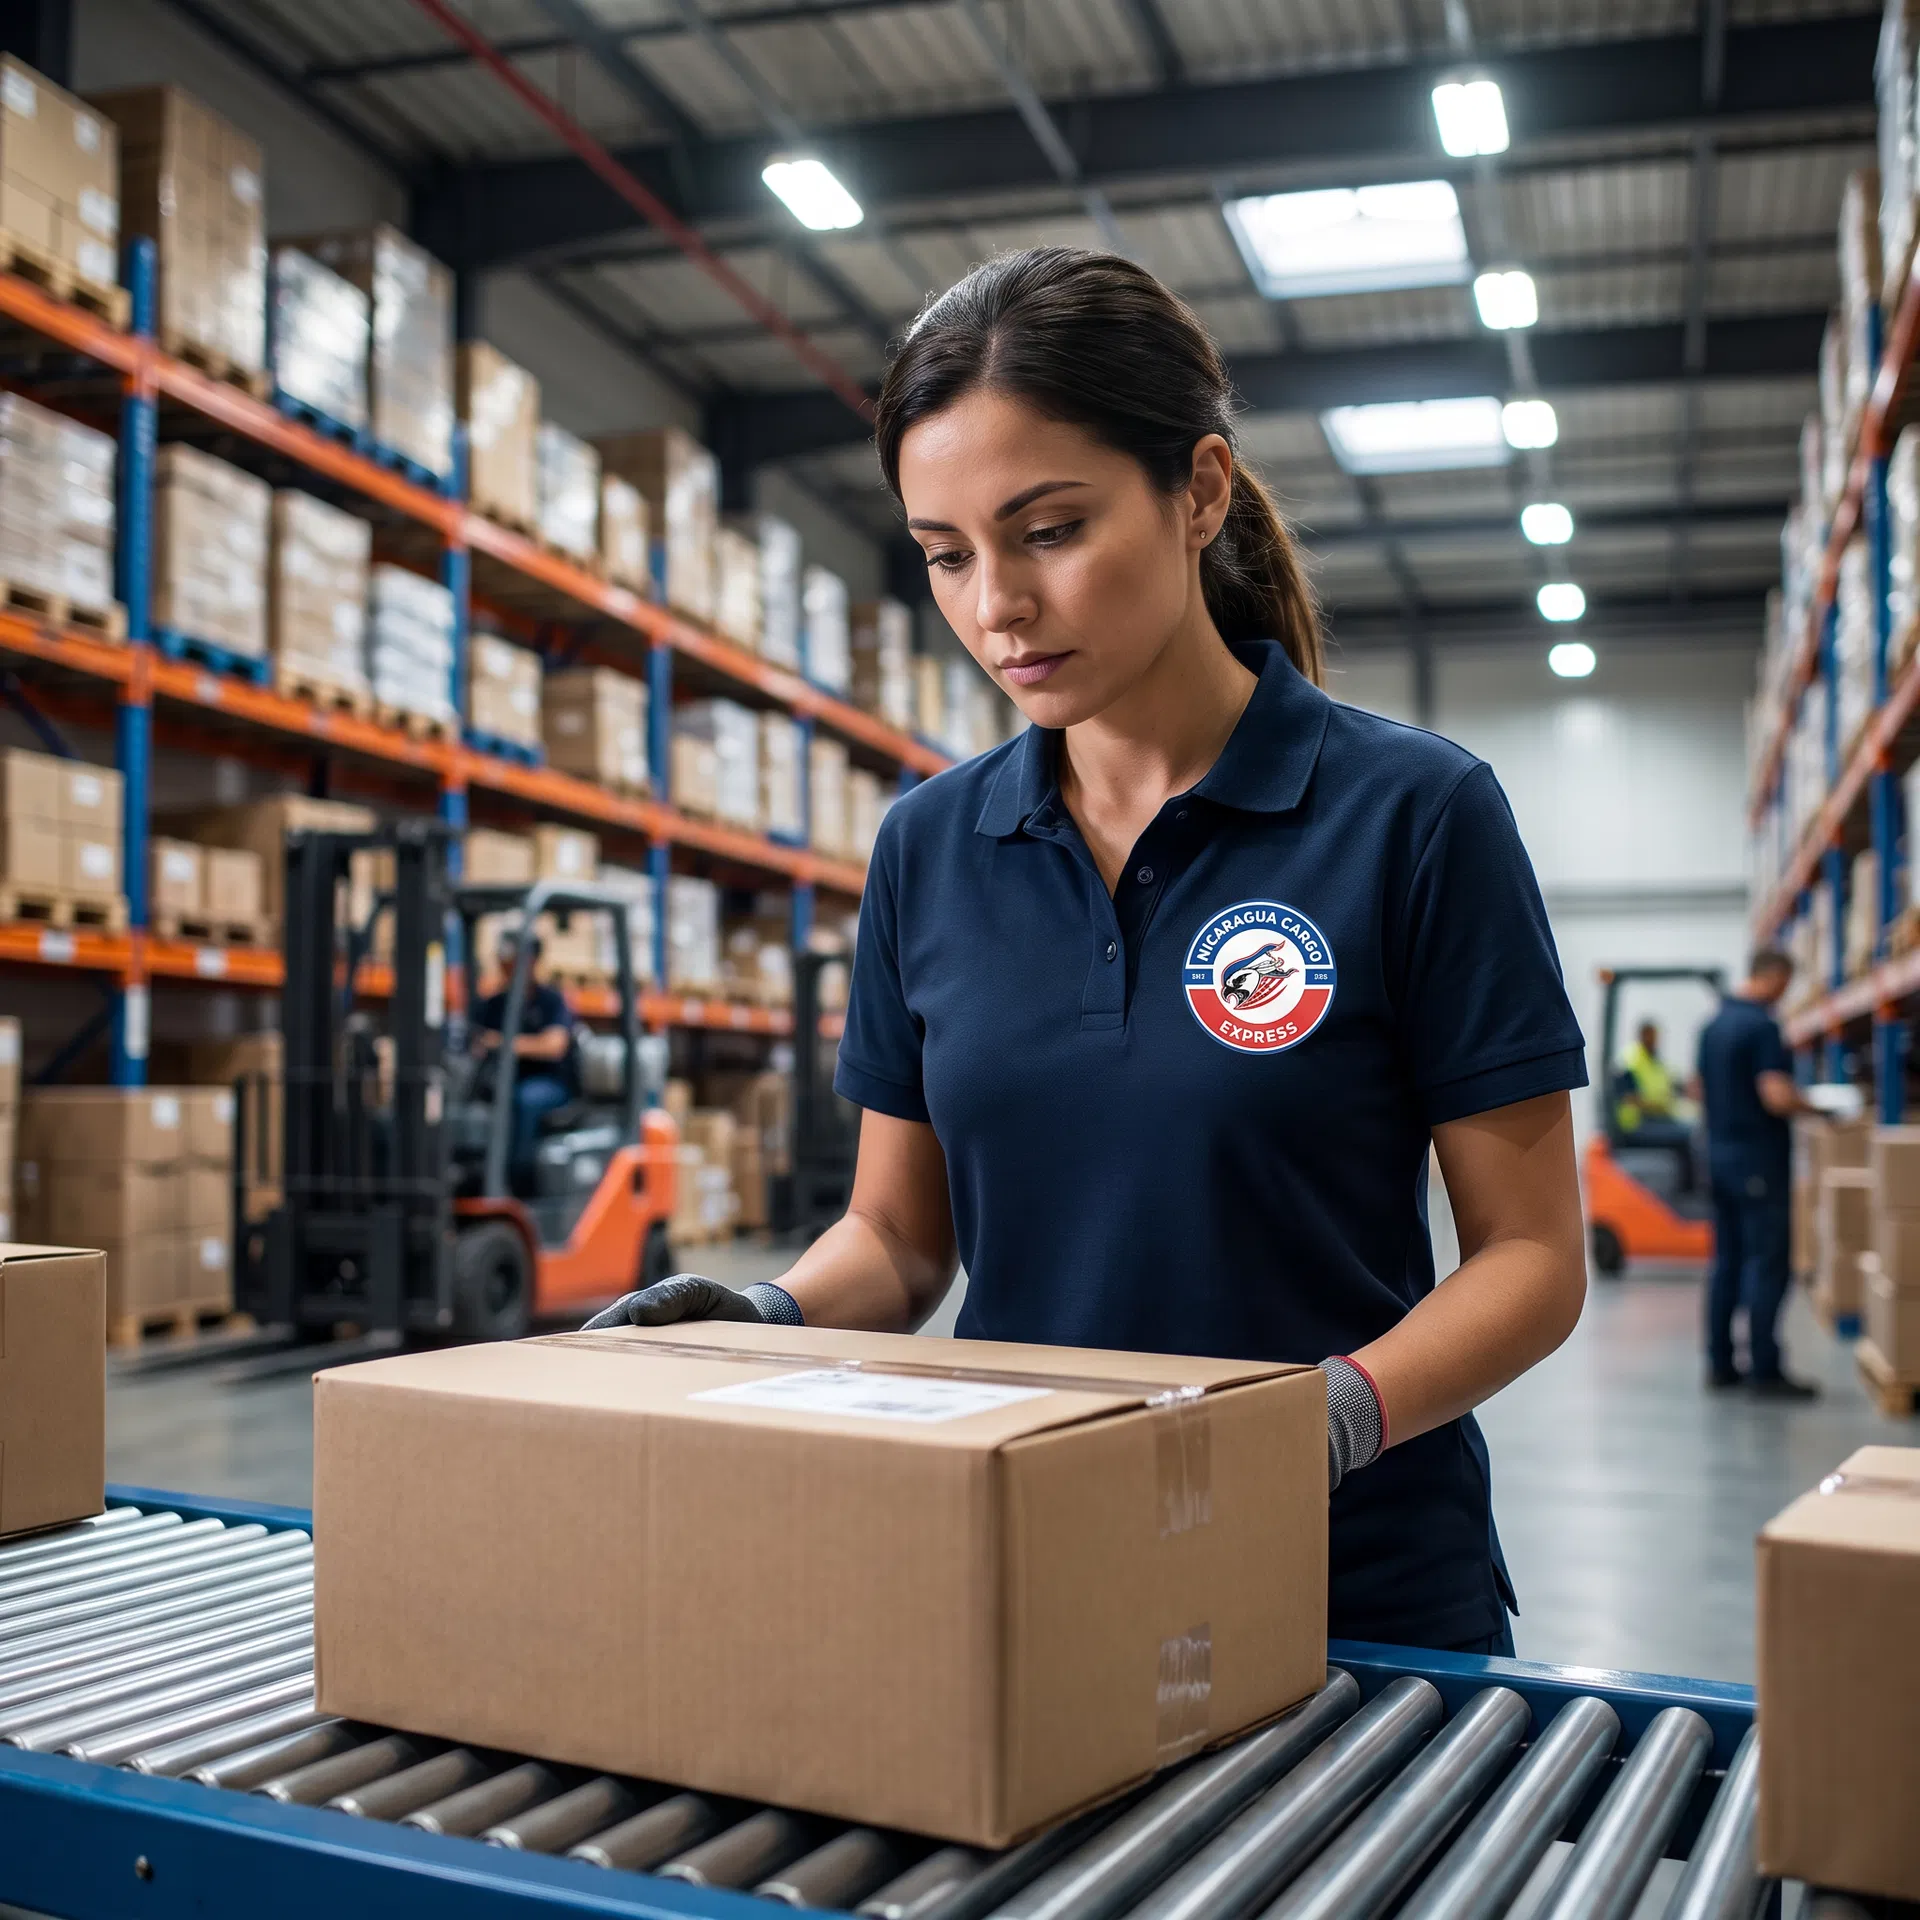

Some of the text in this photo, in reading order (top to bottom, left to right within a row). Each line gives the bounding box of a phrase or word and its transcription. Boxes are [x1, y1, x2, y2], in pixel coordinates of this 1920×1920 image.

[1196, 910, 1322, 962] NICARAGUA CARGO
[1219, 1020, 1298, 1043] EXPRESS
